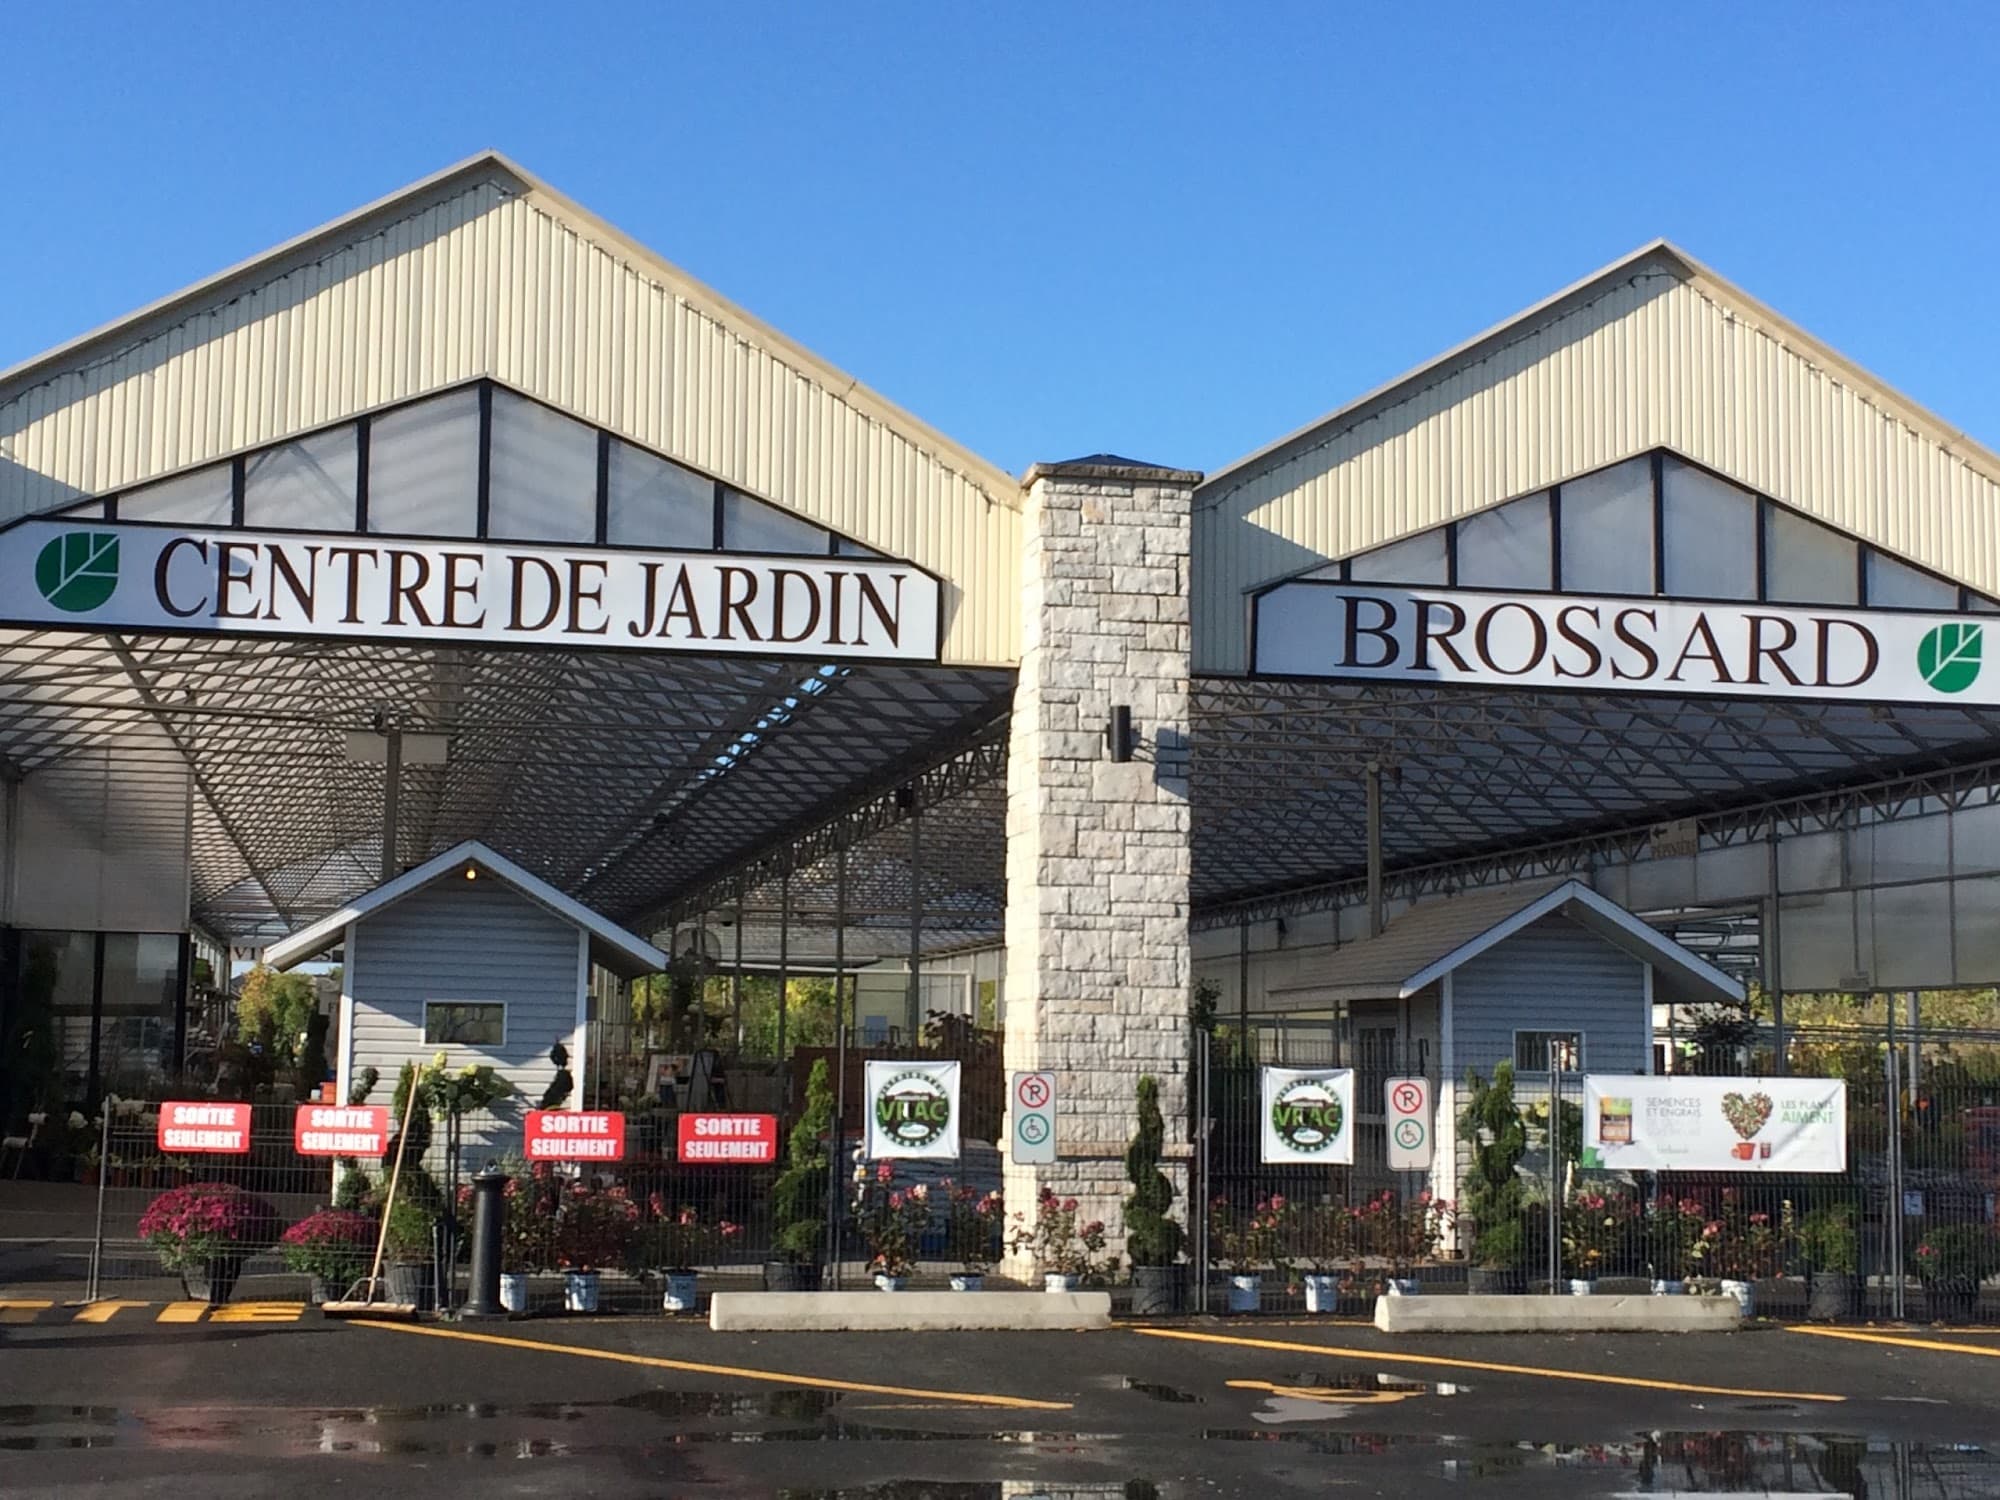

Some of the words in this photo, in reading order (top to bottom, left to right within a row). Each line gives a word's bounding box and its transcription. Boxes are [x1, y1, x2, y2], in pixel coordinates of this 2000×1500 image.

[154, 538, 485, 628] CENTRE
[505, 556, 608, 634] DE
[626, 563, 906, 648] JARDIN
[1334, 596, 1878, 687] BROSSARD
[1647, 1097, 1701, 1107] SEMENCES
[1781, 1100, 1796, 1109] LES
[173, 1106, 235, 1125] SORTIE
[311, 1109, 373, 1128] SORTIE
[1647, 1107, 1657, 1117] ET
[1660, 1107, 1701, 1117] ENGRAIS
[1782, 1111, 1835, 1123] AIMENT
[540, 1115, 609, 1134] SORTIE
[695, 1118, 760, 1136] SORTIE
[164, 1129, 242, 1149] SEULEMENT
[302, 1131, 380, 1151] SEULEMENT
[531, 1138, 617, 1157] SEULEMENT
[685, 1141, 768, 1159] SEULEMENT
